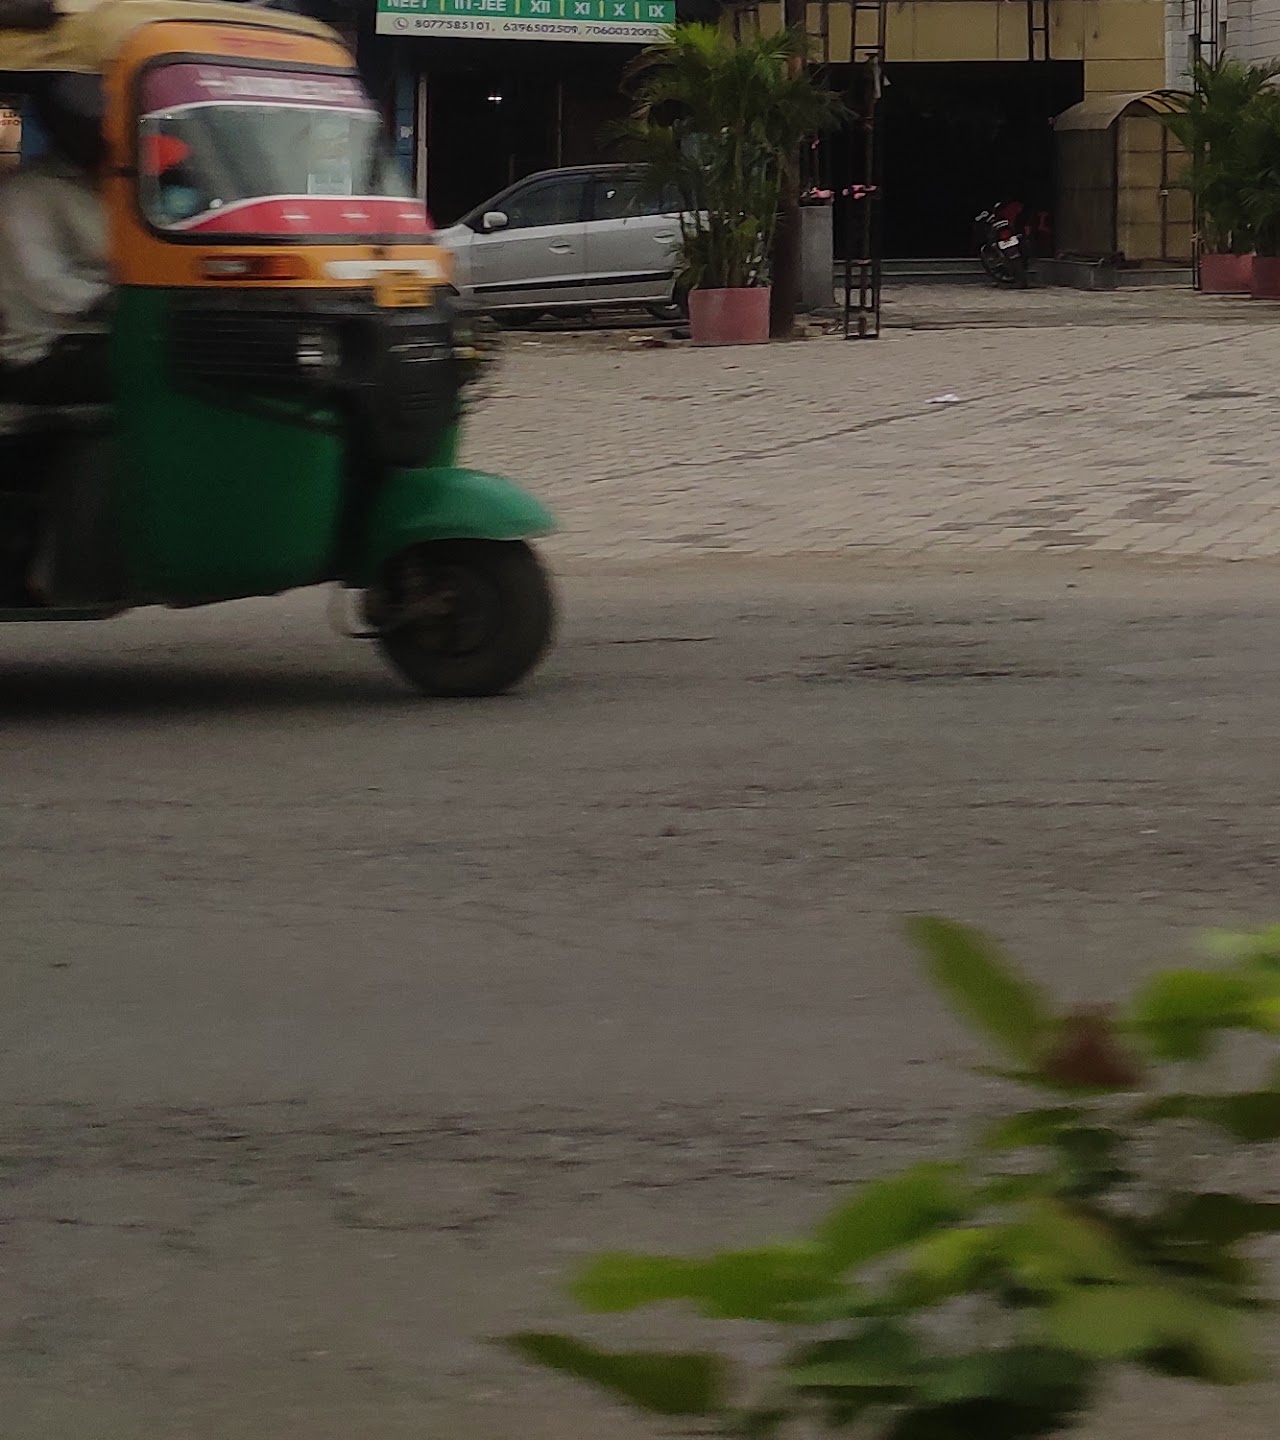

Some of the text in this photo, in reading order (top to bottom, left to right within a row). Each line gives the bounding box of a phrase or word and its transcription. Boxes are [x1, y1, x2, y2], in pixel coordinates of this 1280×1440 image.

[529, 0, 551, 14] XII
[574, 1, 590, 15] XI
[613, 3, 626, 16] X
[648, 5, 665, 18] IX
